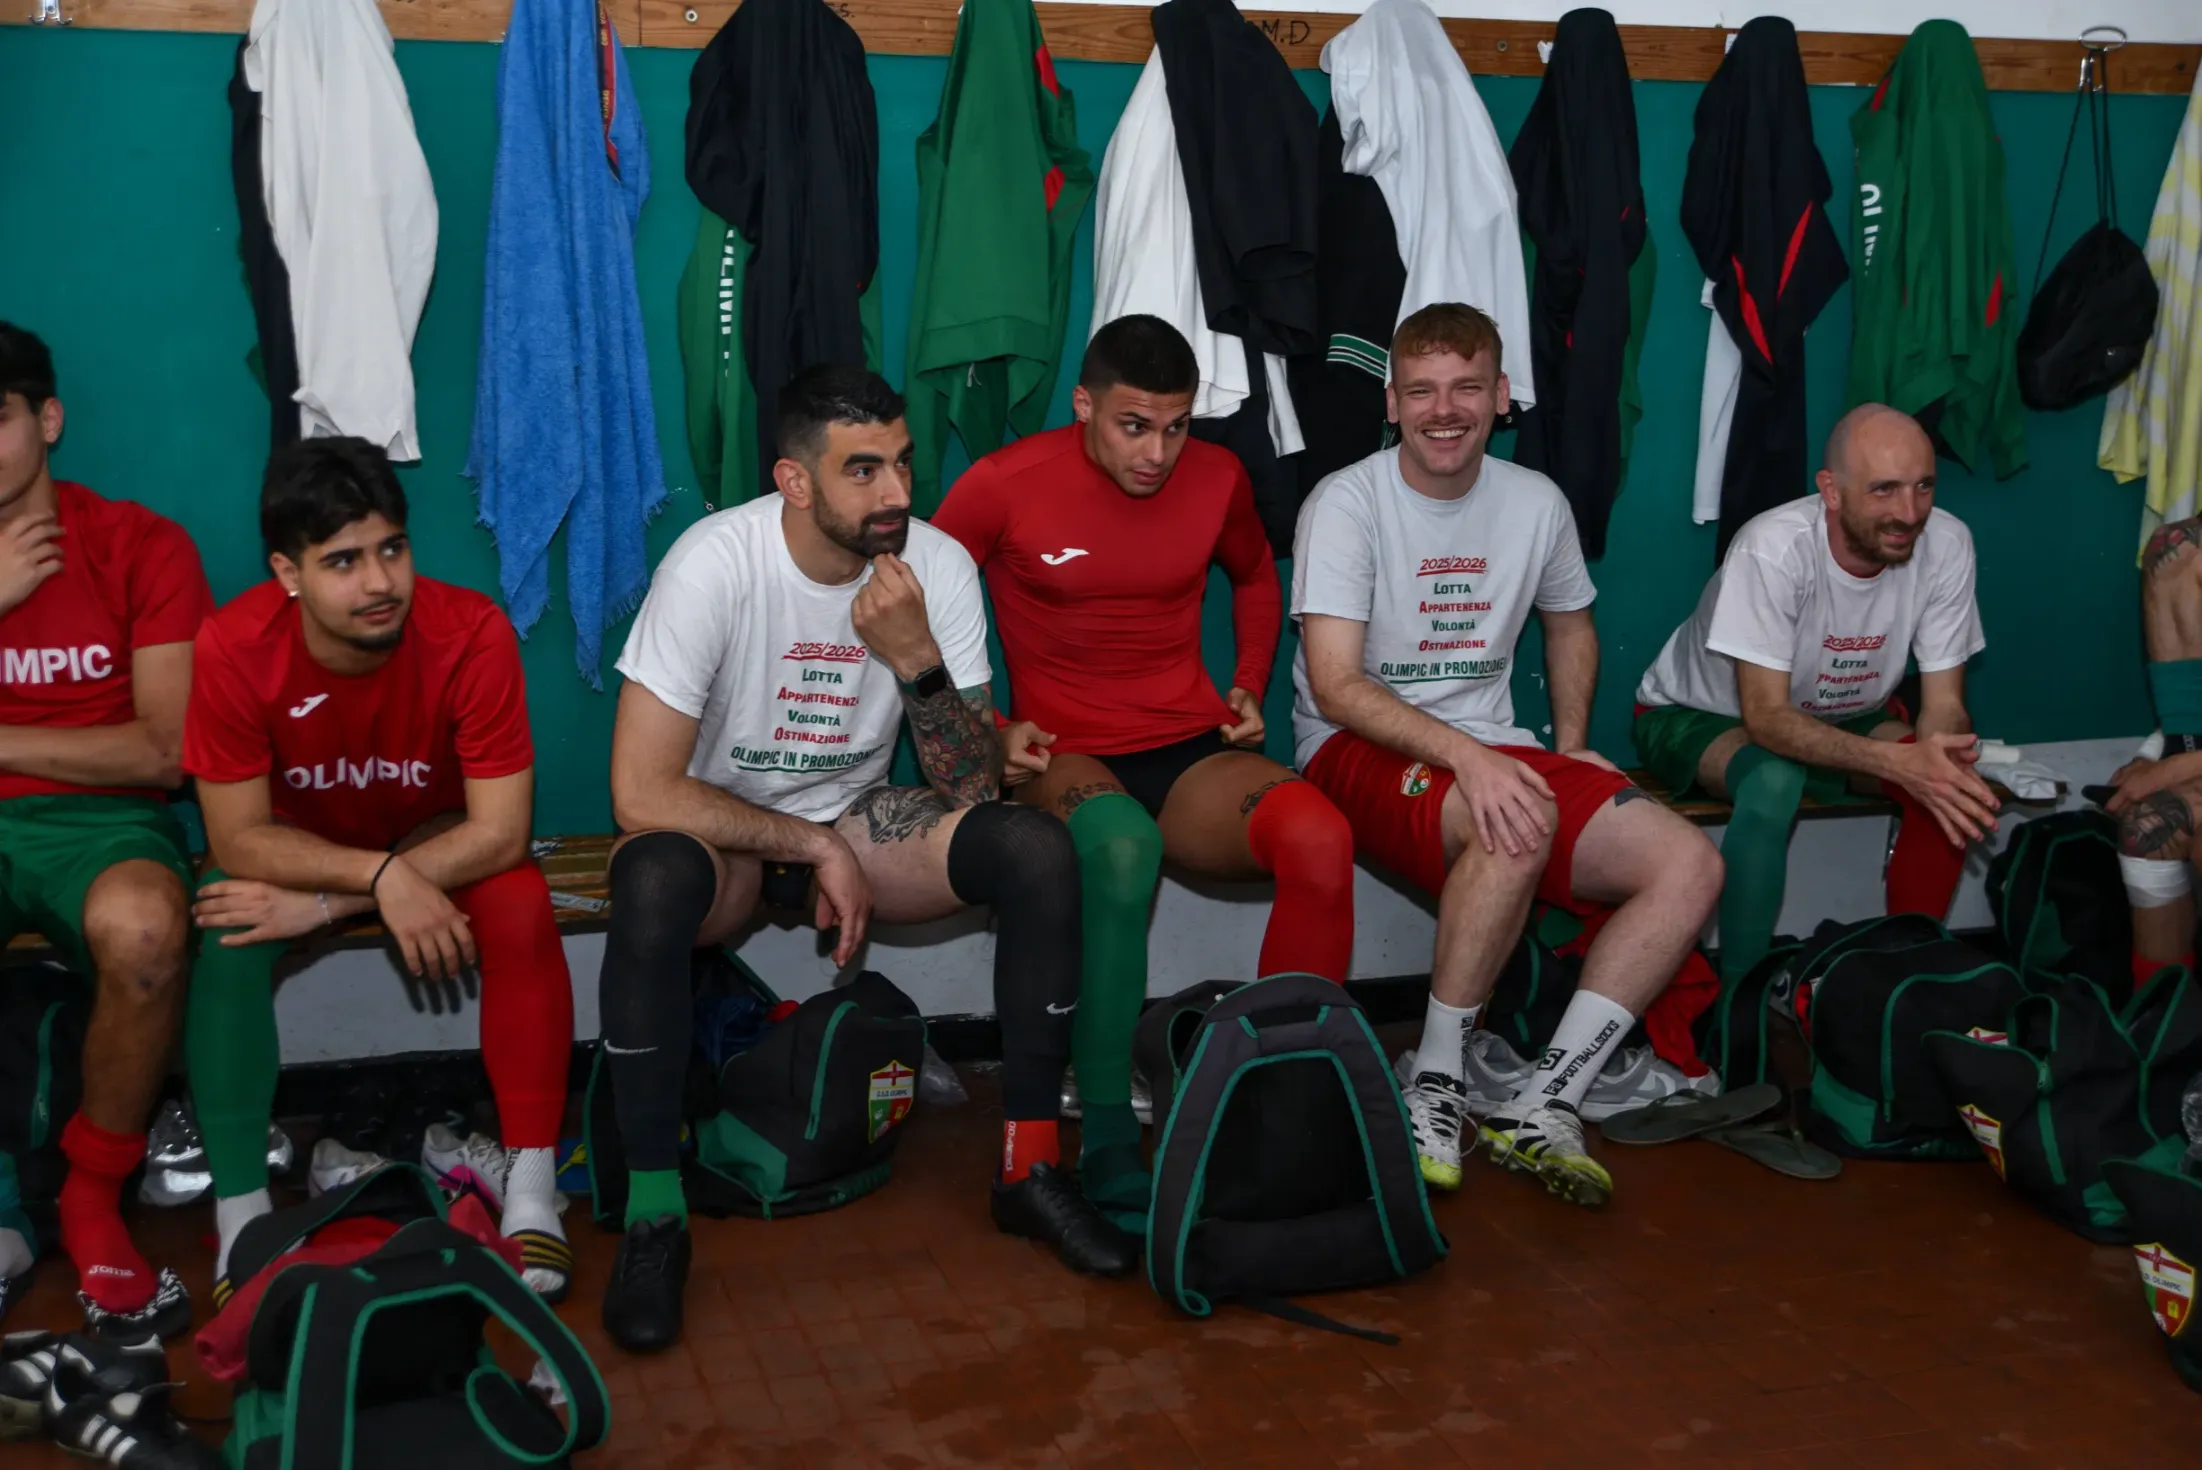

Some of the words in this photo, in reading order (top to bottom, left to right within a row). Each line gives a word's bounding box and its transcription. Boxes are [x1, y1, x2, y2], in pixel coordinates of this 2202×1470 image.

[1420, 555, 1487, 571] 2025/2026
[1433, 582, 1472, 595] LOTTA
[1419, 601, 1492, 614] APPARTENENZA
[788, 642, 867, 659] 2025/2026
[1418, 639, 1487, 652] OSTINAZIONE
[0, 644, 113, 684] MPIC
[1380, 662, 1428, 677] OLIMPIC
[1429, 662, 1441, 676] IN
[802, 668, 843, 684] LOTTA
[787, 709, 841, 726] VOLONTÀ
[774, 727, 850, 744] OSTINAZIONE
[730, 746, 779, 765] OLIMPIC
[783, 750, 798, 767] IN
[800, 745, 880, 768] PROMOZION
[284, 755, 432, 790] OLIMPIC
